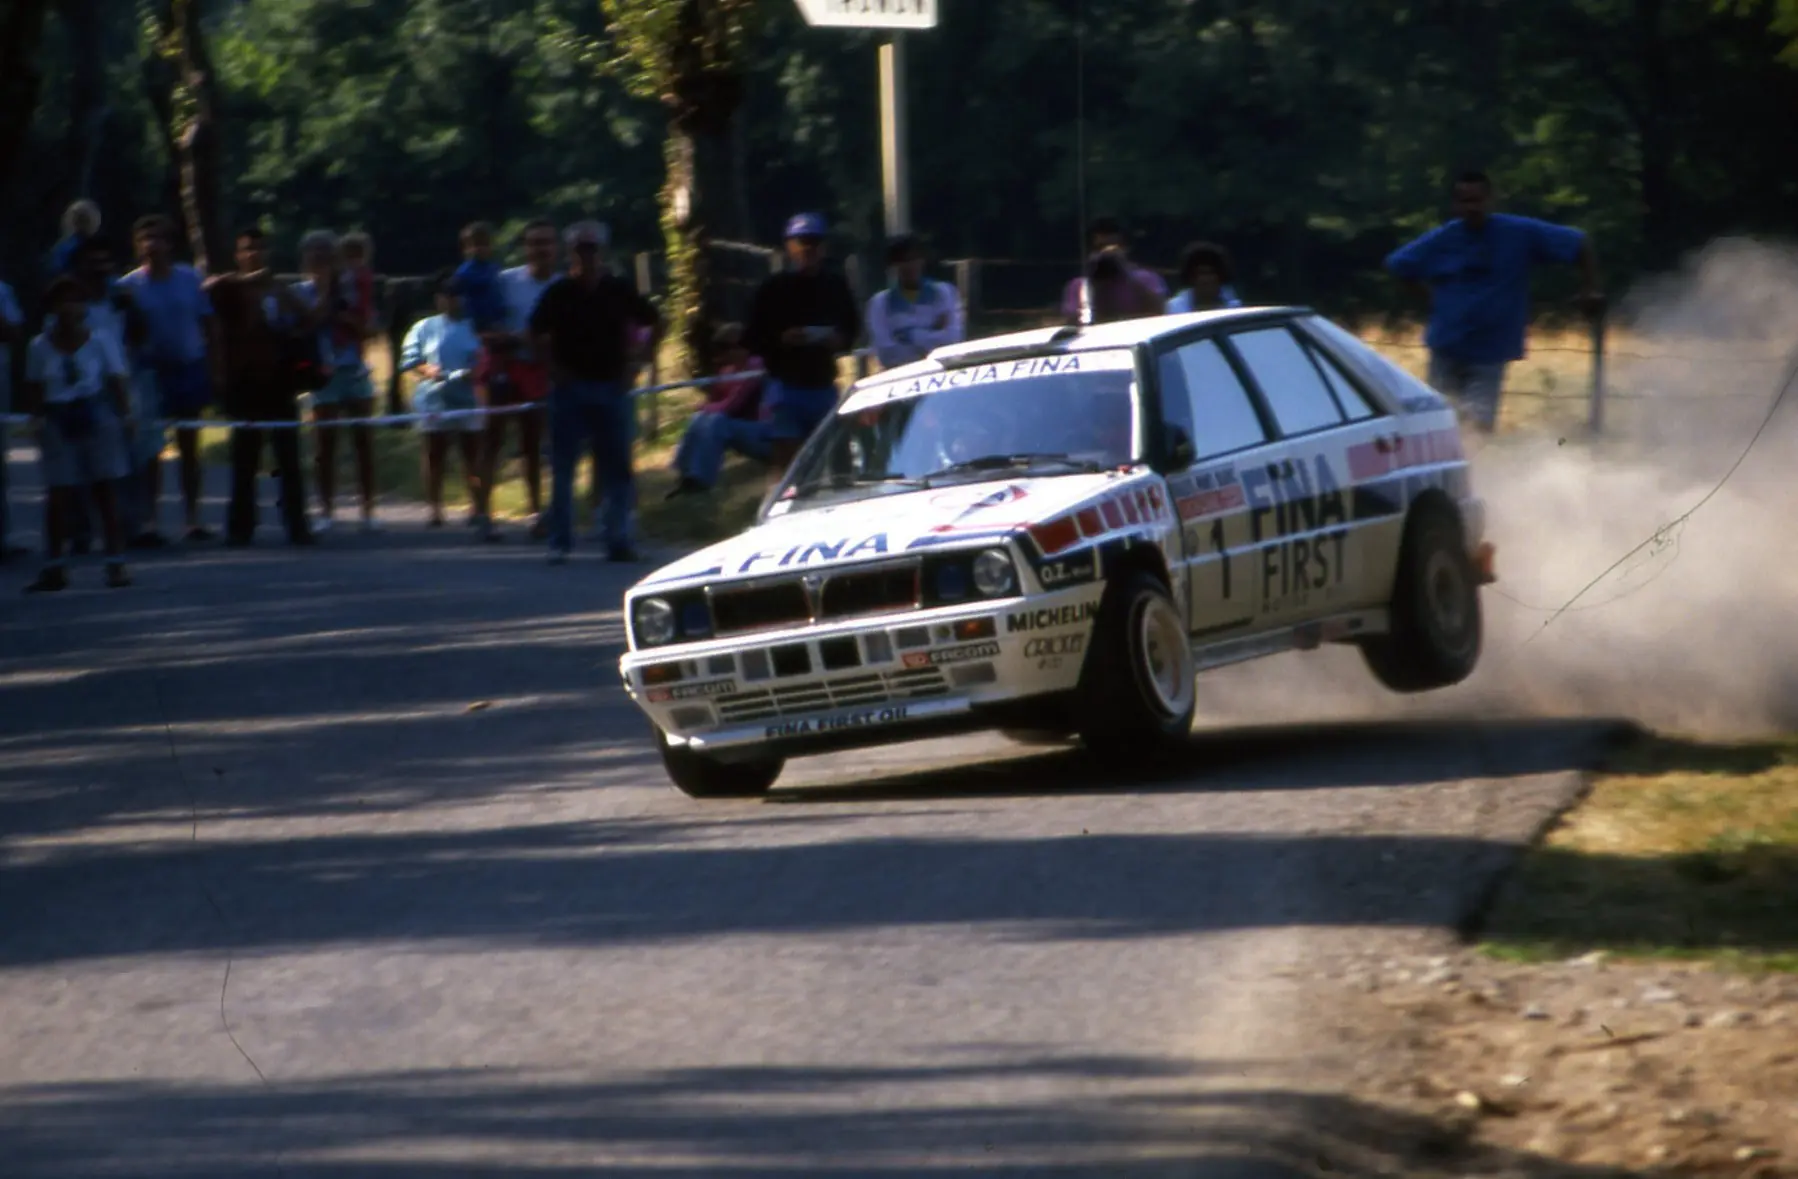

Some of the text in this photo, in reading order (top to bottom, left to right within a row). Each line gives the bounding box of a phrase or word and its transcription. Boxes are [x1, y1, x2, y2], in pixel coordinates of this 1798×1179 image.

[886, 355, 1082, 399] LANCIA FINA
[1241, 452, 1346, 544] FINA
[737, 531, 888, 574] FINA
[1210, 516, 1232, 599] 1
[1262, 528, 1348, 600] FIRST
[1007, 601, 1099, 633] MICHELIN
[765, 720, 812, 739] FINA
[817, 711, 875, 732] FIRST
